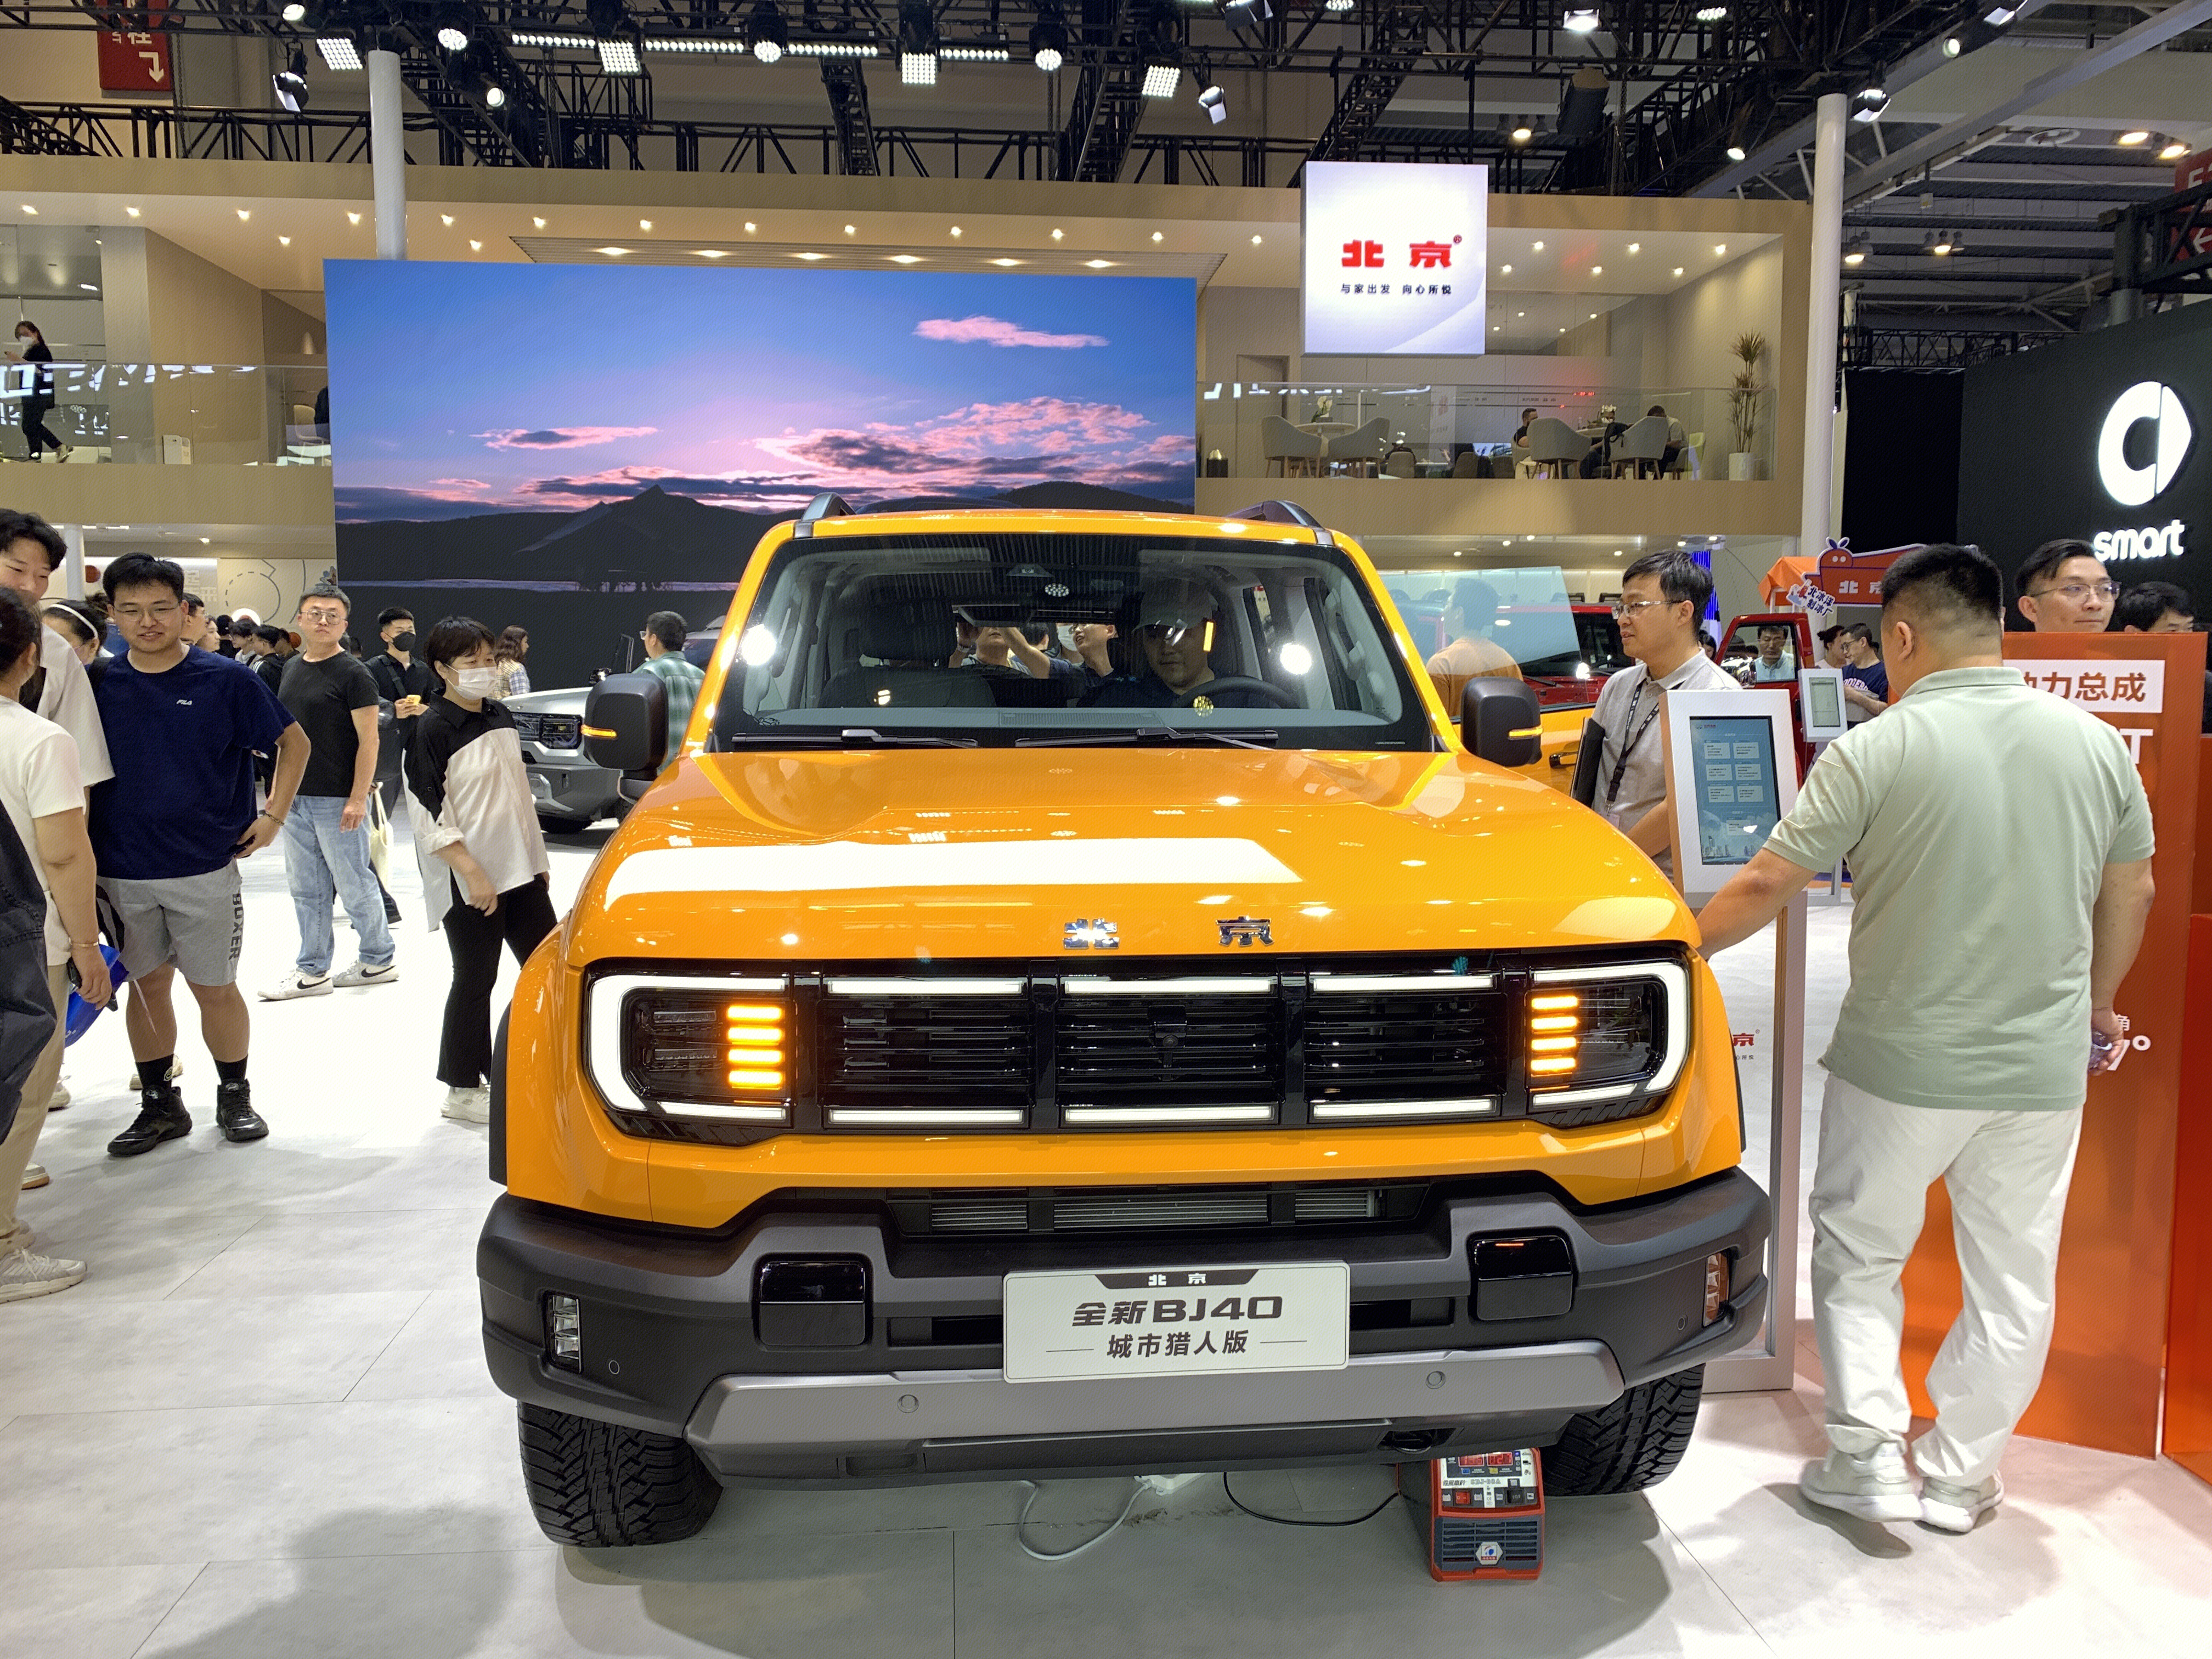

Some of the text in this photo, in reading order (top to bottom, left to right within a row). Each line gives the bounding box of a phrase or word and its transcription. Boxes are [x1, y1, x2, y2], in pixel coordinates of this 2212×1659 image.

[1341, 240, 1452, 269] 北京
[1340, 283, 1452, 295] 与家出发 向心所悦
[2094, 519, 2185, 562] smart
[1807, 586, 1835, 606] 北冰洋
[1807, 599, 1833, 616] 制冰厂
[1063, 915, 1274, 950] 北京
[1148, 1273, 1208, 1286] 北京
[1106, 1329, 1249, 1359] 城市猎人版
